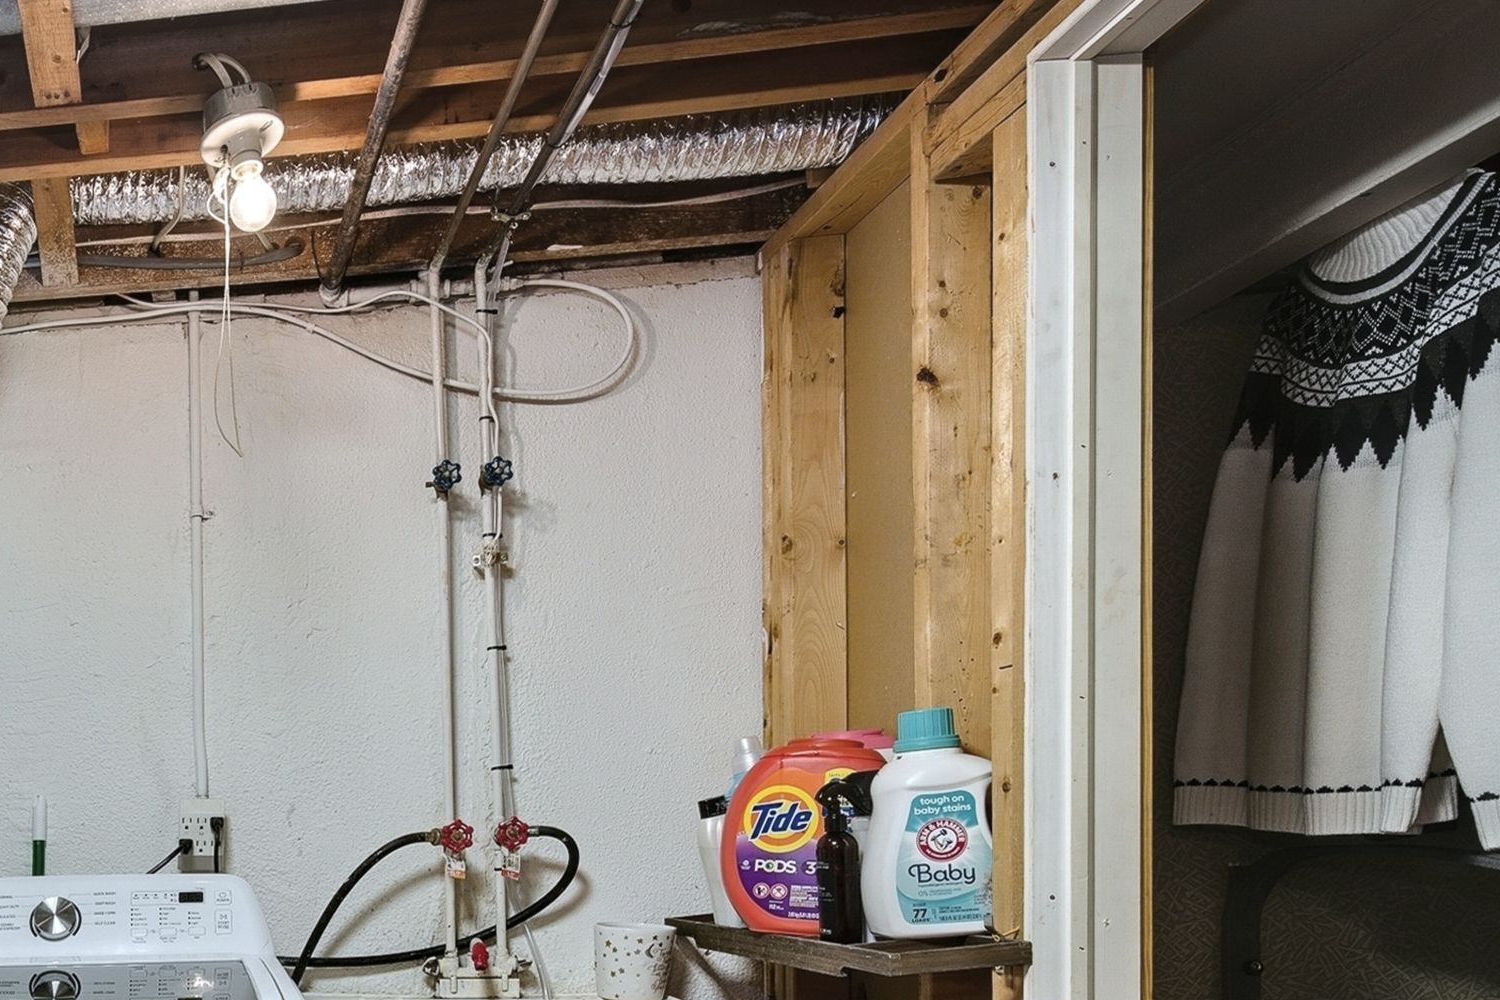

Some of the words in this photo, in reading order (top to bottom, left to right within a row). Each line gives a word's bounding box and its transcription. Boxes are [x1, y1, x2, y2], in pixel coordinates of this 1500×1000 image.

[920, 795, 950, 805] tough
[914, 805, 940, 815] baby
[942, 803, 971, 813] stains
[750, 801, 813, 840] Tide
[919, 828, 930, 846] ARM
[754, 859, 797, 874] PODS
[805, 861, 817, 875] 3
[907, 863, 976, 885] Baby
[912, 908, 928, 919] 77
